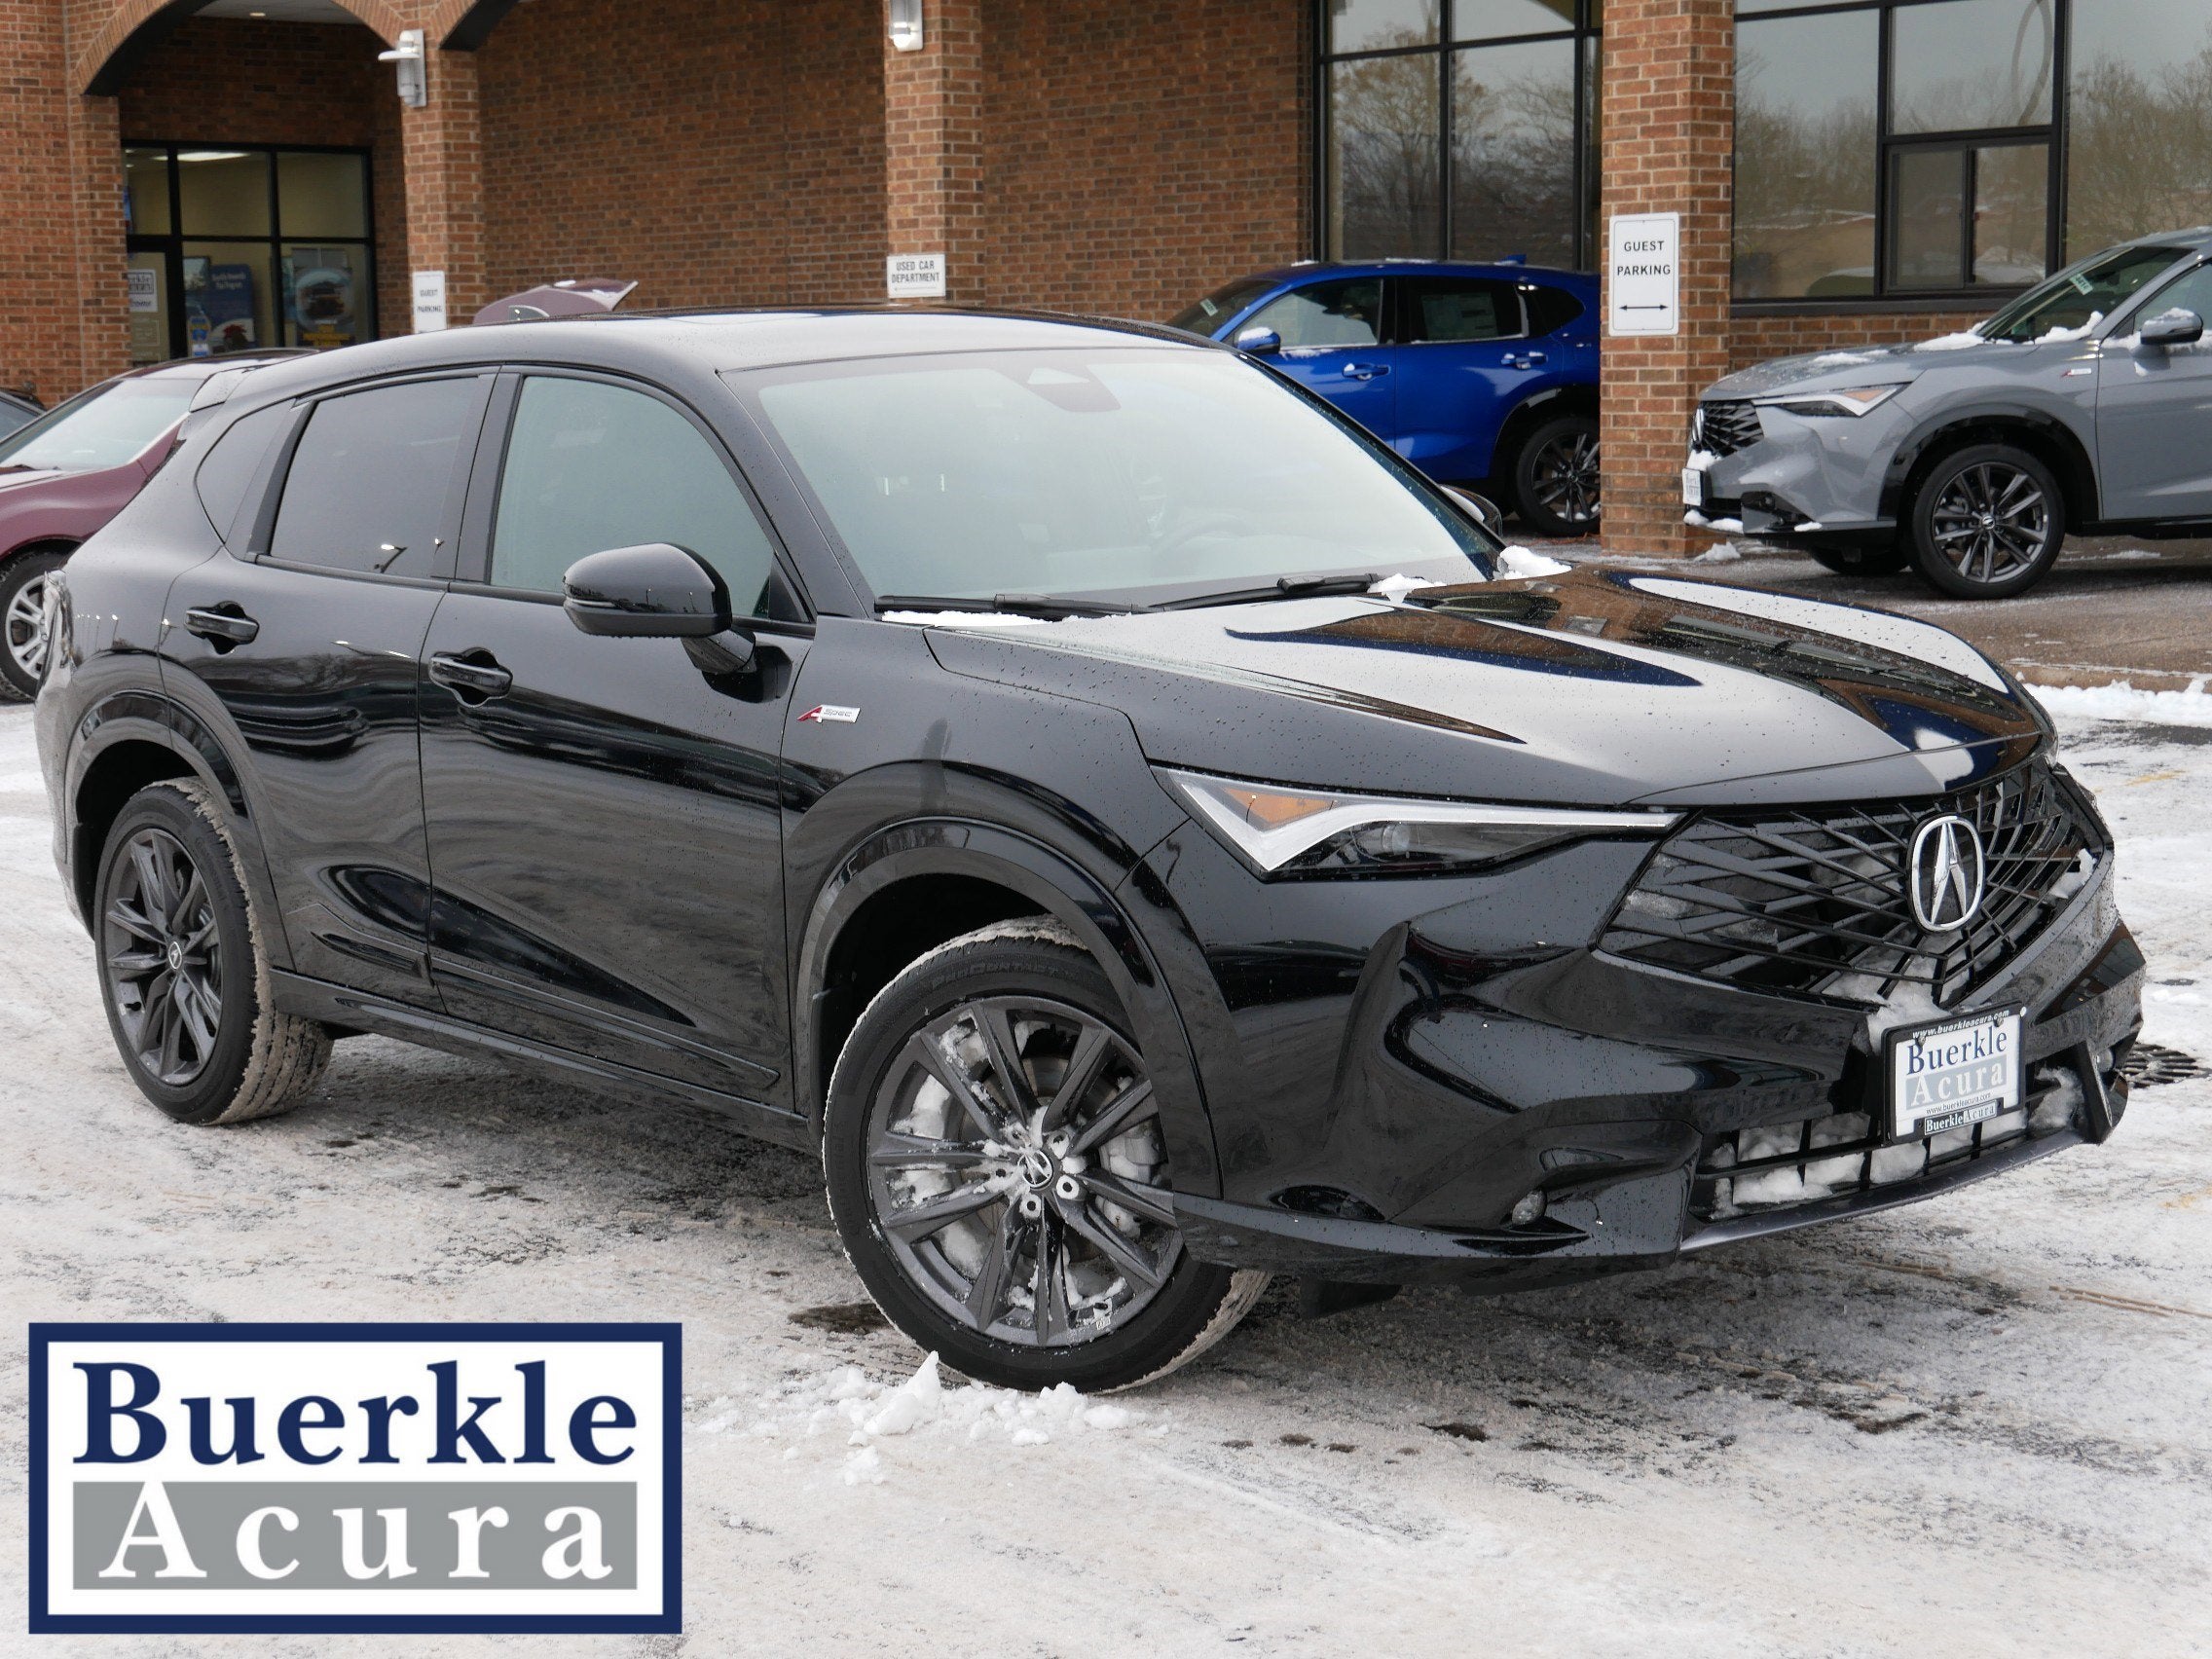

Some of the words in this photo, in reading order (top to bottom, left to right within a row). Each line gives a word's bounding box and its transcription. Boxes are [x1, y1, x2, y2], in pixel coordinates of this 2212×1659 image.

[1624, 240, 1665, 252] GUEST
[896, 261, 916, 271] USED
[919, 260, 935, 270] CAR
[1617, 264, 1671, 276] PARKING
[892, 273, 940, 283] DEPARTMENT
[1912, 1010, 2009, 1039] www.buerkleacura.com
[1906, 1025, 2008, 1075] Buerkle
[1911, 1061, 2004, 1107] Acura
[1926, 1092, 1991, 1115] www.buerkleacura.com
